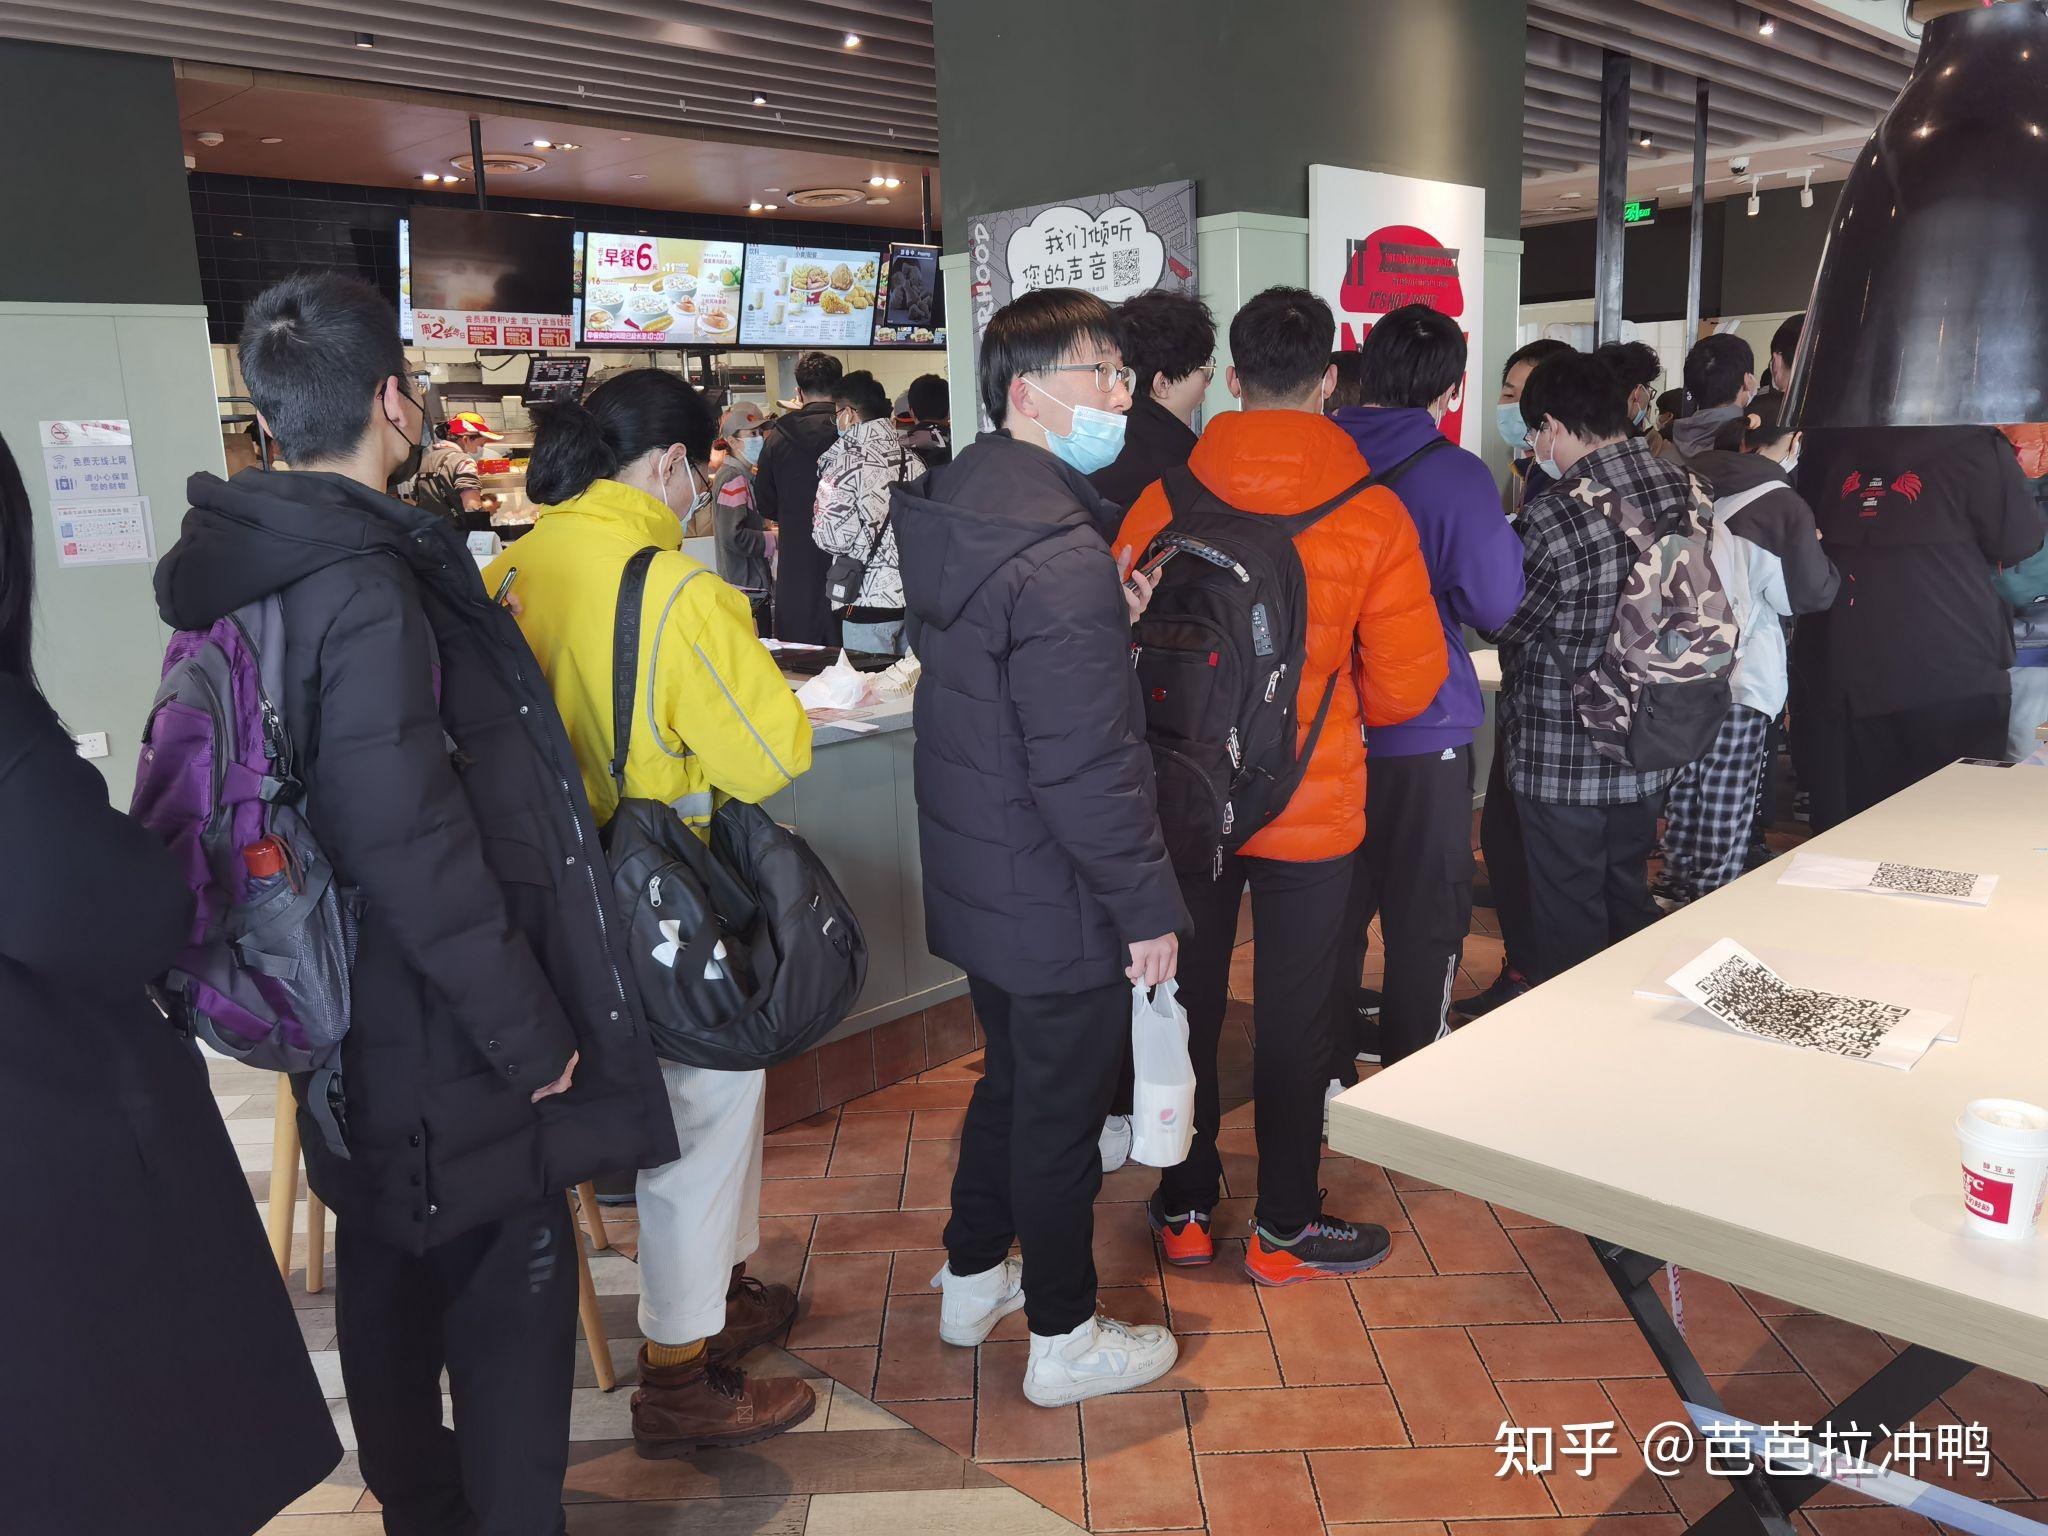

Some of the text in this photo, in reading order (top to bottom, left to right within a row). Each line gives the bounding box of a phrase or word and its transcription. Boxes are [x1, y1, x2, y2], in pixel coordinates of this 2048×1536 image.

[1044, 217, 1133, 254] 我们倾听
[1022, 251, 1107, 289] 您的声音
[1346, 238, 1367, 286] IT
[73, 456, 127, 467] 免费无线上网
